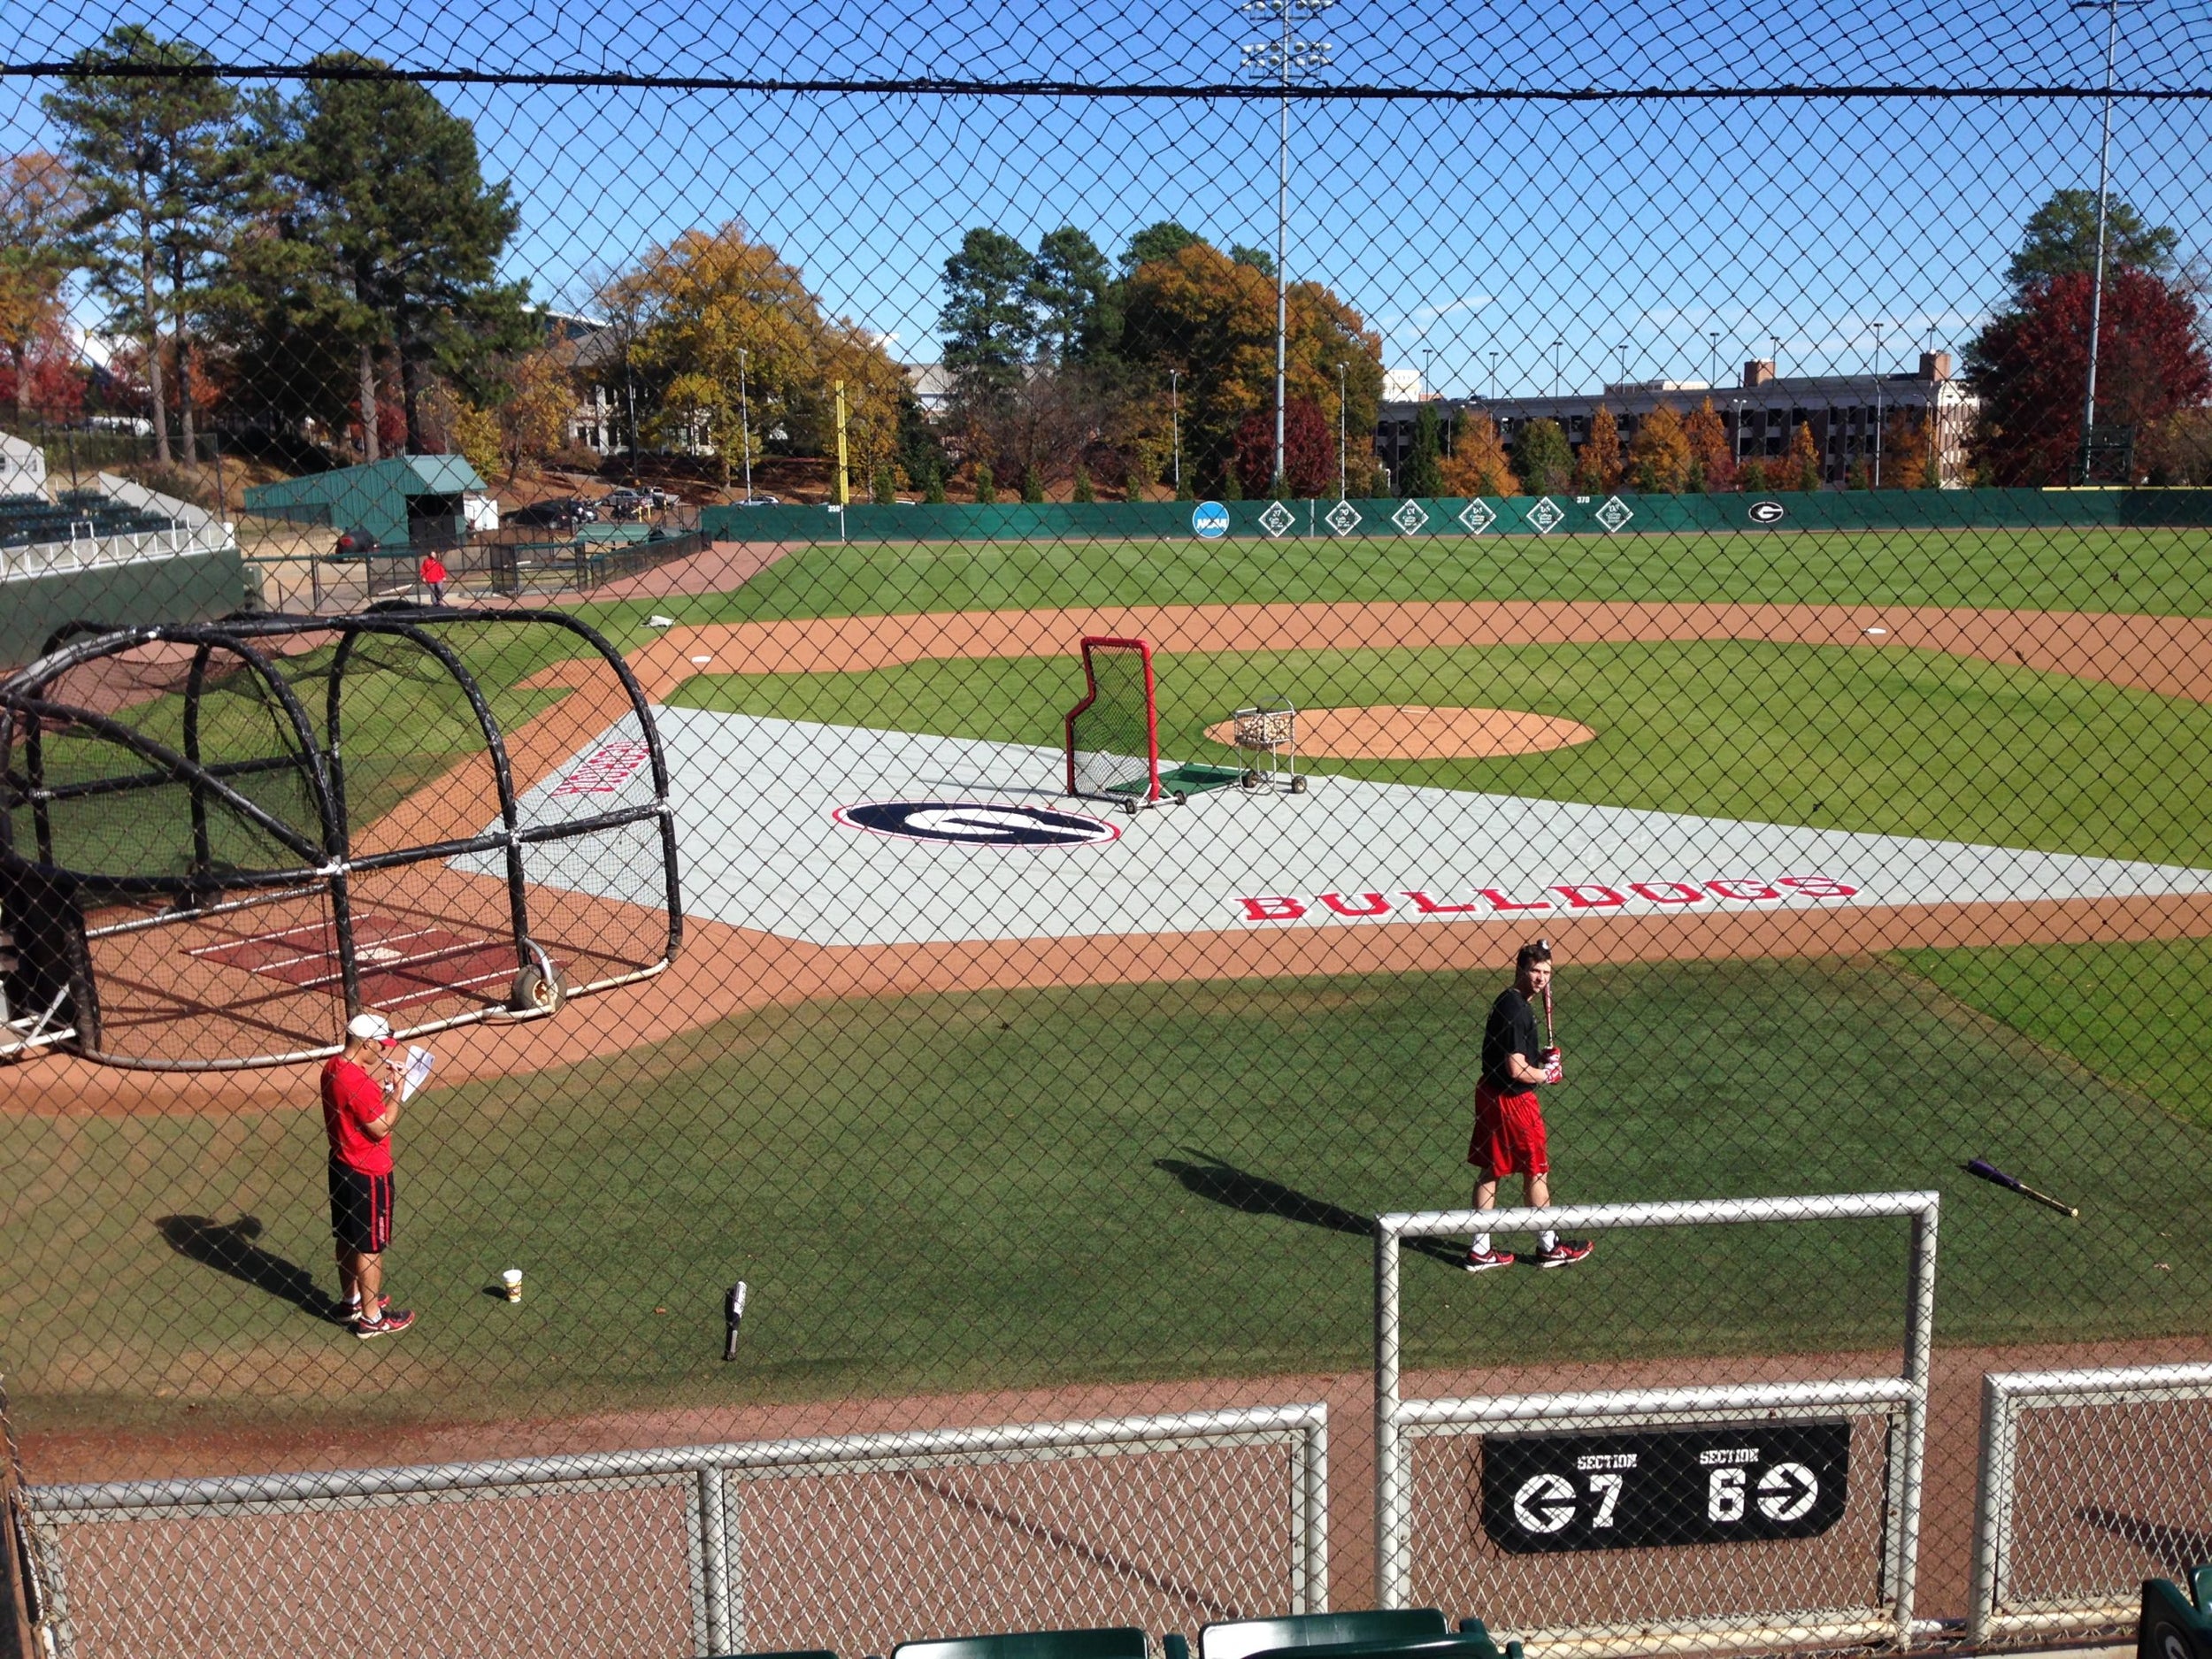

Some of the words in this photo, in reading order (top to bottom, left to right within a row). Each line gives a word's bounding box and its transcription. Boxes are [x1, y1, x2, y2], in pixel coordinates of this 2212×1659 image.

[1233, 876, 1858, 921] BULLDOGS
[1577, 1453, 1638, 1471] SECTION
[1700, 1448, 1760, 1465] SECTION
[1589, 1473, 1624, 1528] 7
[1708, 1468, 1747, 1523] 6
